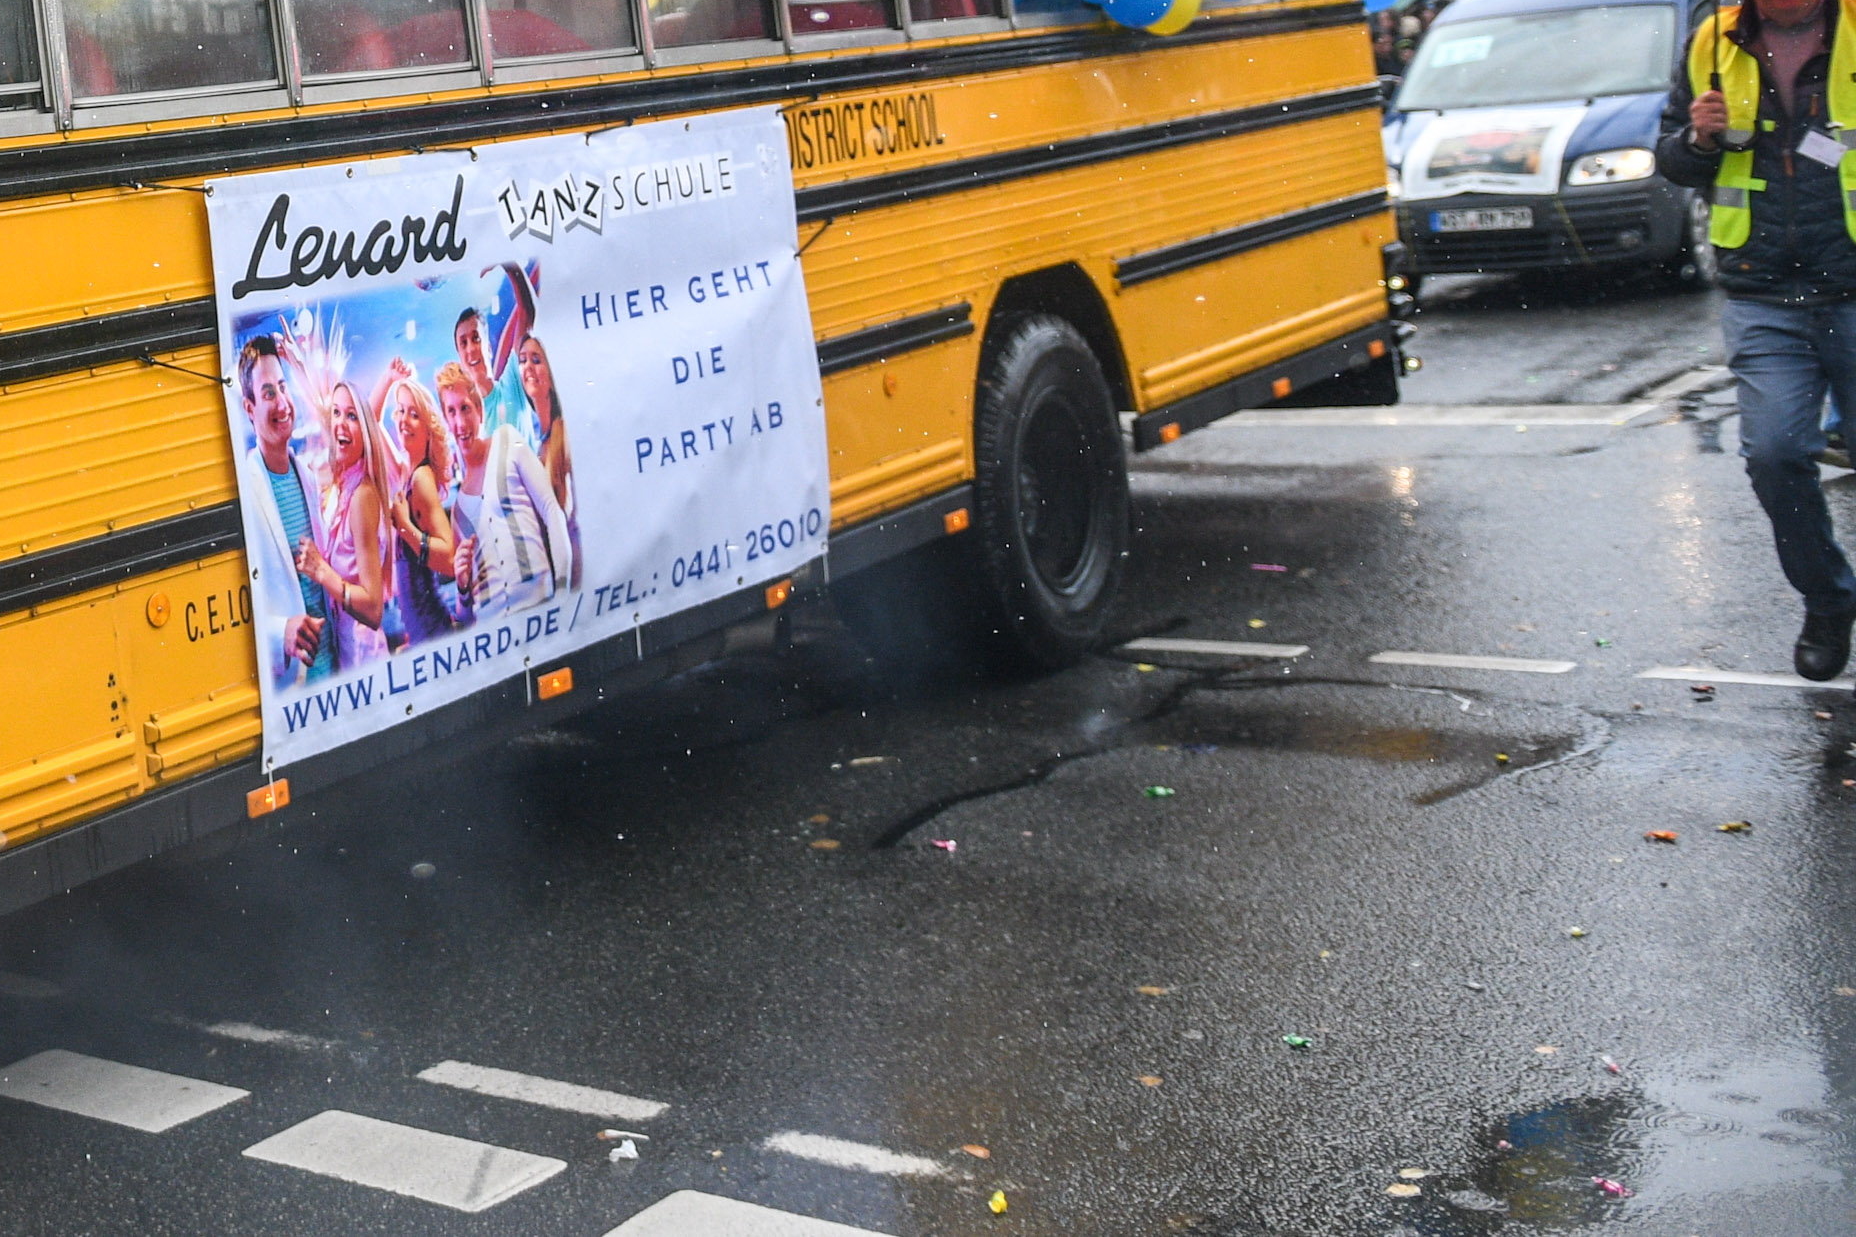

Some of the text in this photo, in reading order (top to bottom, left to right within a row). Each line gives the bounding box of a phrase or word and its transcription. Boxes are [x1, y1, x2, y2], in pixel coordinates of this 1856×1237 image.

[871, 93, 943, 155] SCHOOL
[232, 174, 467, 300] Lenard
[581, 261, 771, 329] HIER GEHT
[672, 346, 726, 385] DIE
[635, 402, 784, 474] PARTY AB
[672, 539, 732, 587] 0441
[746, 508, 822, 561] 26010
